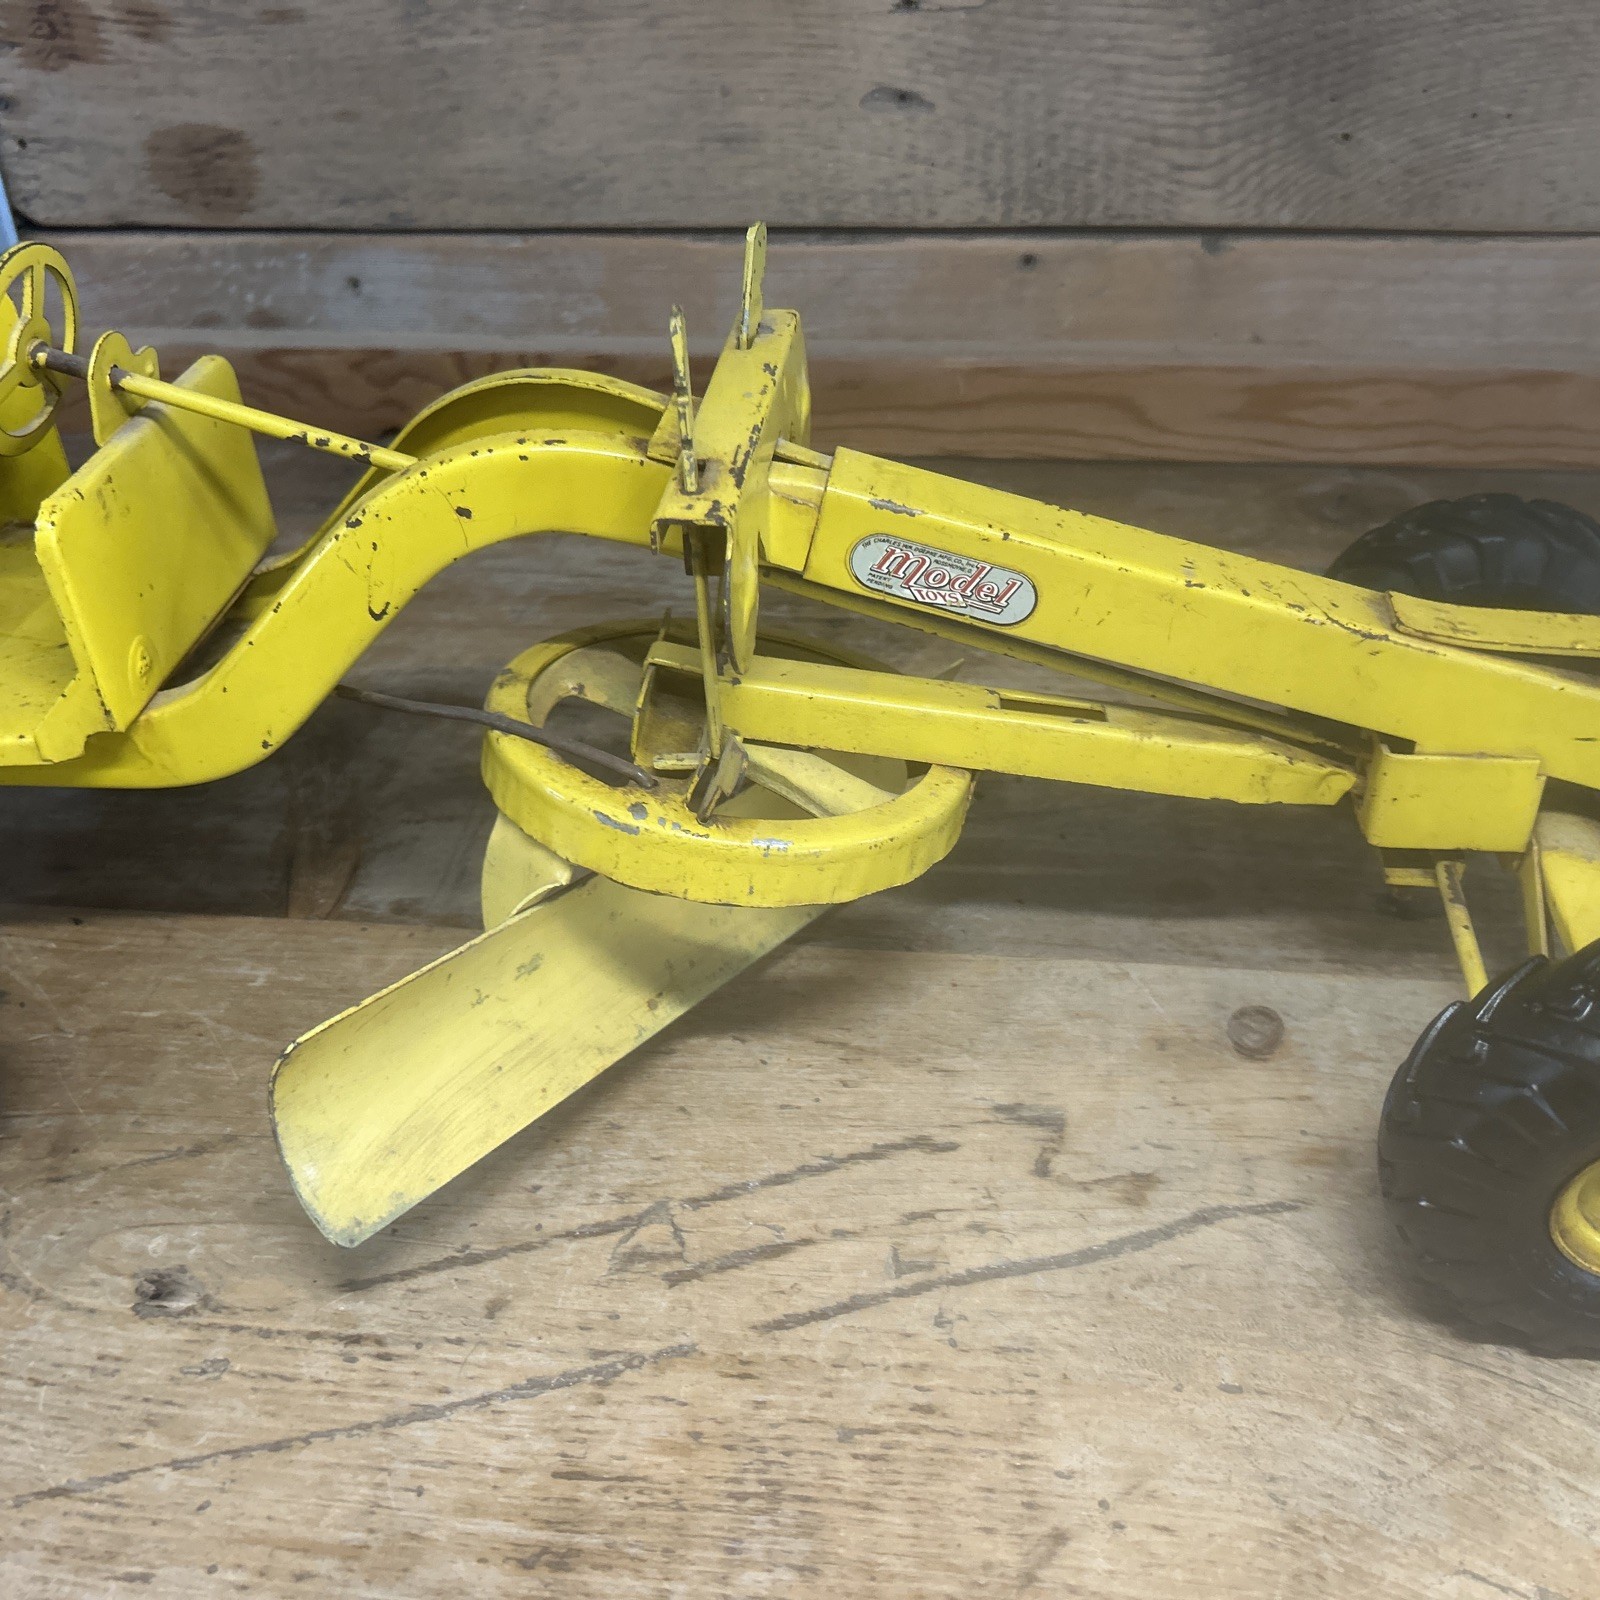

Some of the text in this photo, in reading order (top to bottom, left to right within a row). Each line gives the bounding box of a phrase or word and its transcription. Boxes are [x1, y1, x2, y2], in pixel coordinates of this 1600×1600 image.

[873, 537, 902, 547] CHARLES
[867, 572, 893, 583] PATENT
[866, 578, 894, 590] PENDING
[913, 588, 960, 605] TOYS
